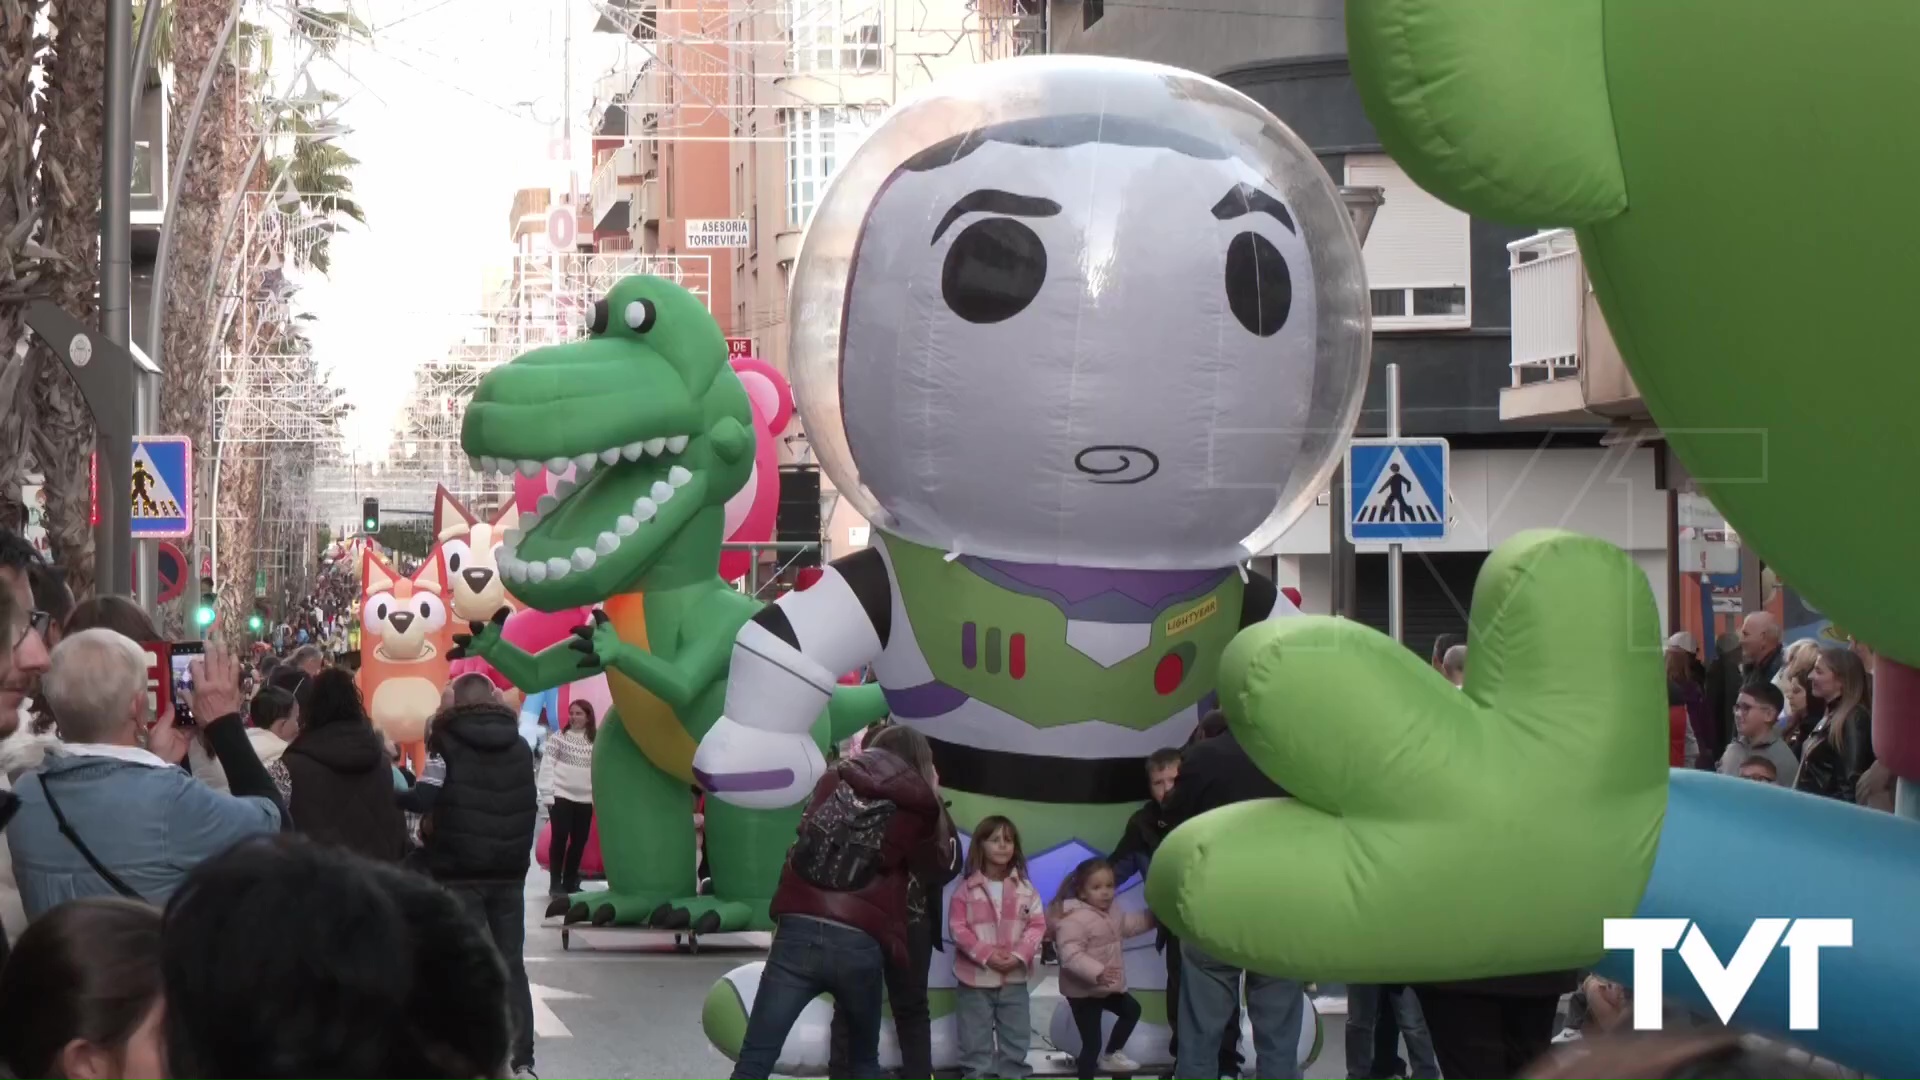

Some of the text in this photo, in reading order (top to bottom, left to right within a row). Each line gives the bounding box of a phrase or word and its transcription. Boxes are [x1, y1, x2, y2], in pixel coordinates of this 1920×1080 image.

[702, 221, 748, 232] ASESORIA
[688, 235, 748, 246] TORREVIEJA
[733, 341, 747, 352] DE
[1167, 600, 1216, 631] LIGHTYEAR
